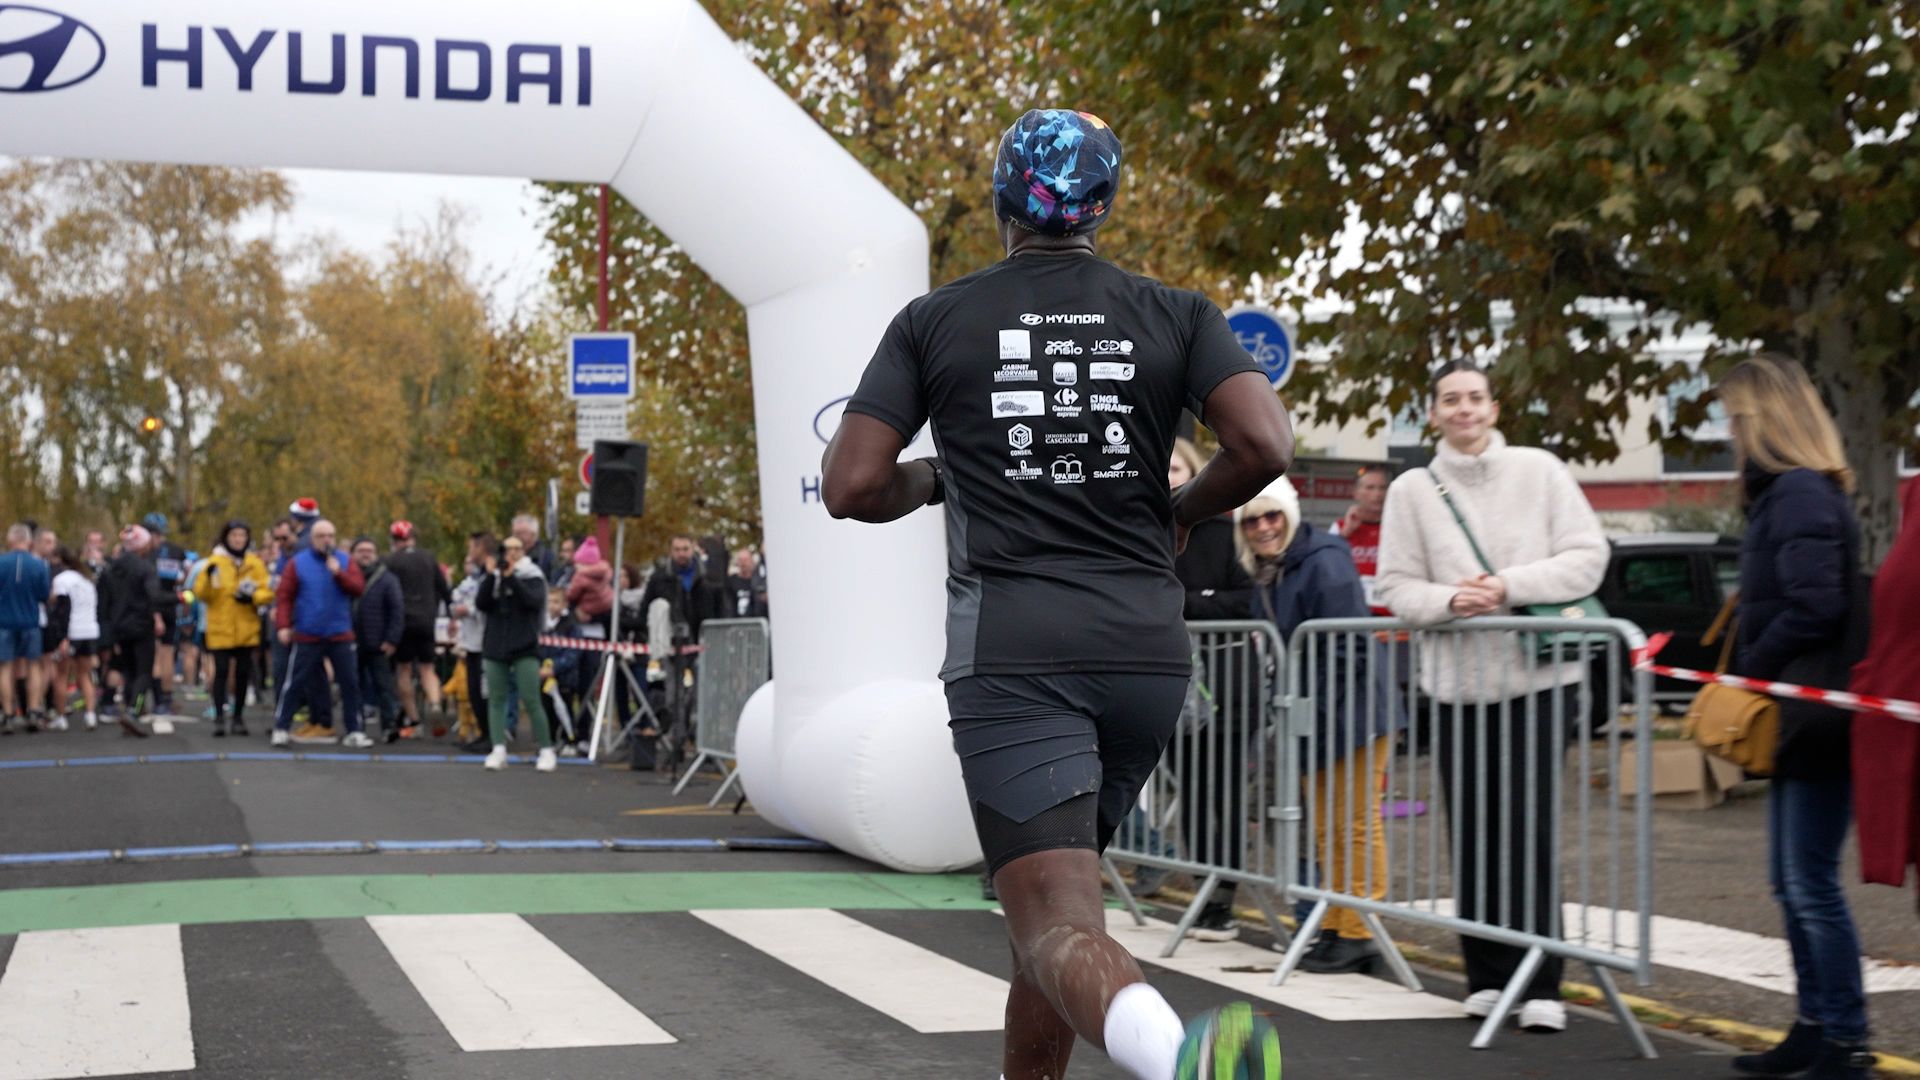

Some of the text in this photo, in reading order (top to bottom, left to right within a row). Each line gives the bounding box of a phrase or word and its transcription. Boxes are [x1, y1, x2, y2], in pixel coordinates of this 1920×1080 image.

[142, 23, 592, 107] HYUNDAI
[1046, 314, 1105, 325] HYUNDAI
[1099, 394, 1119, 403] NGE
[1051, 404, 1083, 412] Carrefour
[1091, 403, 1134, 414] INFRANET
[1010, 449, 1033, 457] CONSEIL
[1093, 470, 1139, 479] SMART TP
